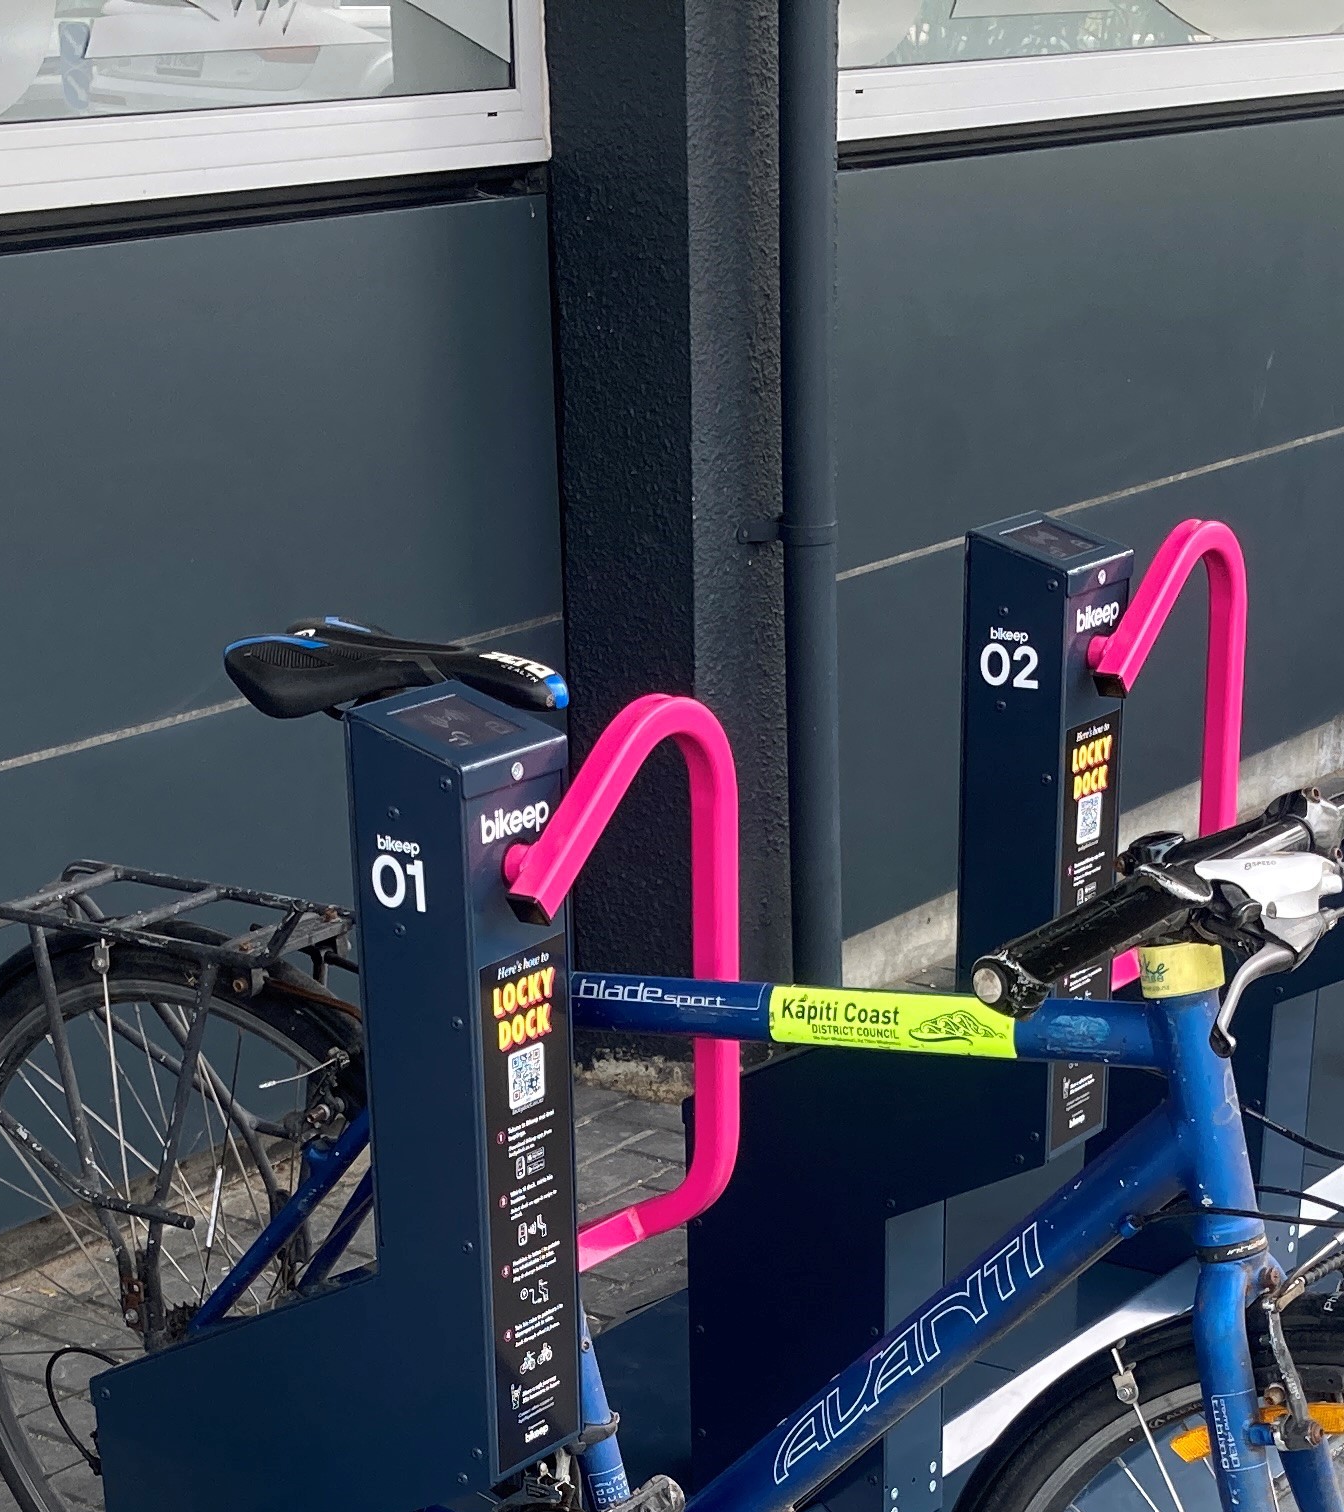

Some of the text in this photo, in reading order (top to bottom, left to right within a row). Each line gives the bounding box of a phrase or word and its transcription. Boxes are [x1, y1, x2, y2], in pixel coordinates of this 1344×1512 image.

[989, 626, 1029, 644] bikeep
[1076, 600, 1120, 634] bikeep
[980, 643, 1039, 690] 02
[1072, 734, 1113, 774] LOCKY
[1073, 765, 1109, 801] DOCK
[480, 800, 550, 845] bikeep
[376, 834, 420, 858] bikeep
[371, 854, 426, 913] 01
[497, 951, 549, 981] Here's how to
[492, 966, 556, 1019] LOCKY
[579, 978, 726, 1008] blade sport
[498, 1002, 553, 1052] DOCK
[844, 1001, 900, 1026] Coast
[811, 1024, 900, 1040] DISTRICT COUNCIL
[773, 1220, 1045, 1486] AVANTI
